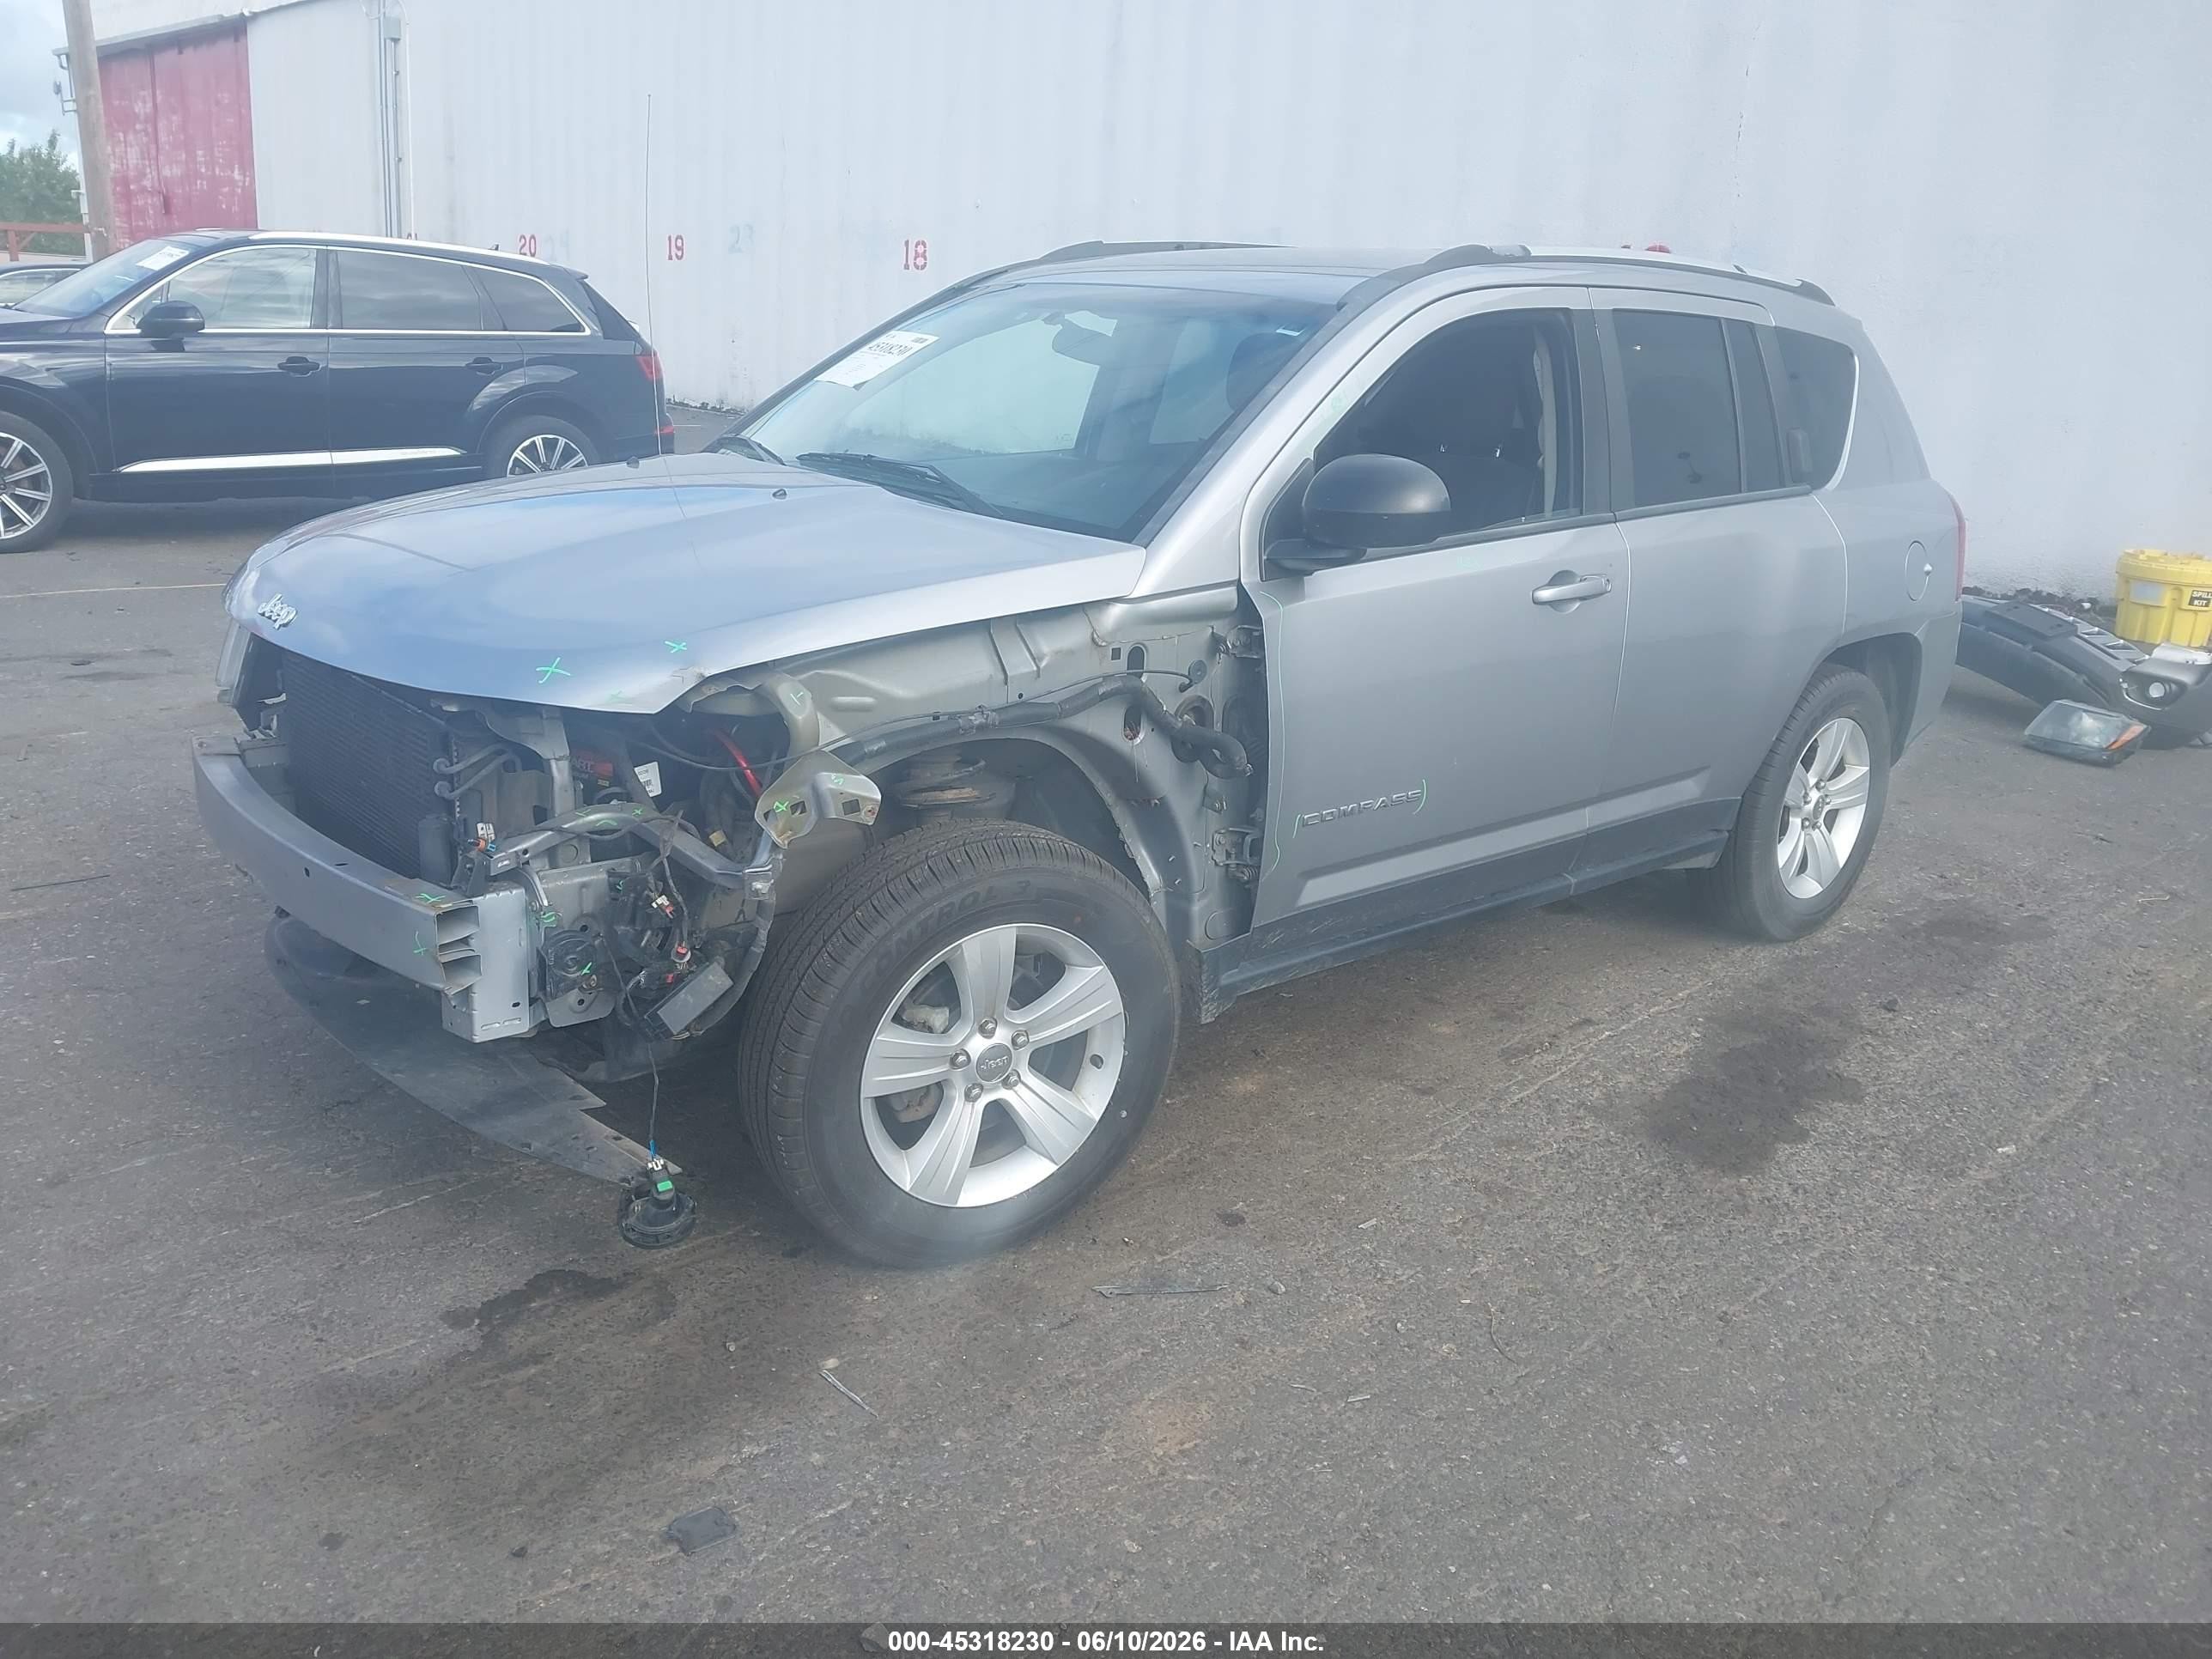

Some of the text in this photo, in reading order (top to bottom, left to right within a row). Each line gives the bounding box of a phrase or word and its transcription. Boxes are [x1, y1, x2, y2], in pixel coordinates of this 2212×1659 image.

[519, 234, 537, 257] 20
[667, 234, 684, 260] 19
[903, 240, 927, 270] 18
[2192, 590, 2212, 599] SPILL
[258, 592, 298, 630] Jeep
[1302, 789, 1422, 827] COMPASS
